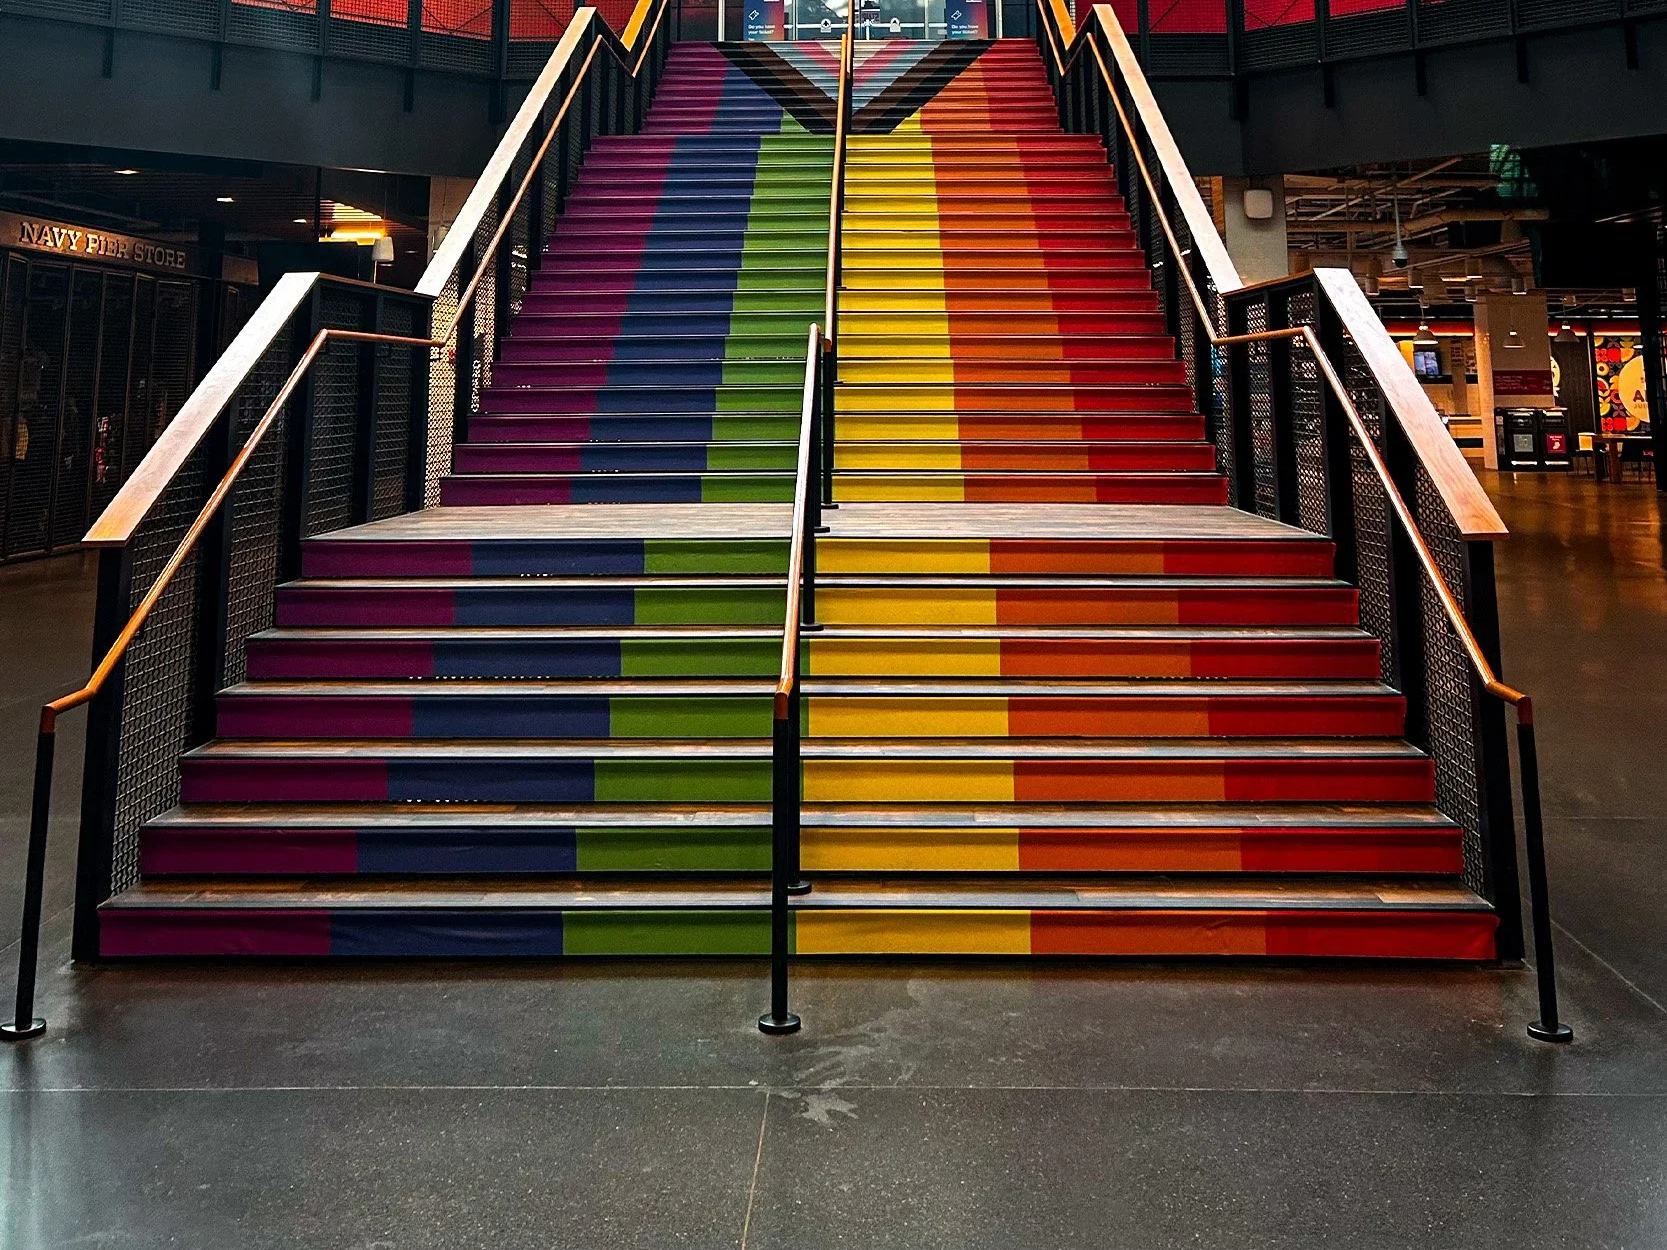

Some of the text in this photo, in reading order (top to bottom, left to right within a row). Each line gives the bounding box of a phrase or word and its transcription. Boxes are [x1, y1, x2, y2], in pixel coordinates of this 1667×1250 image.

[20, 222, 187, 269] NAVY PIER STORE
